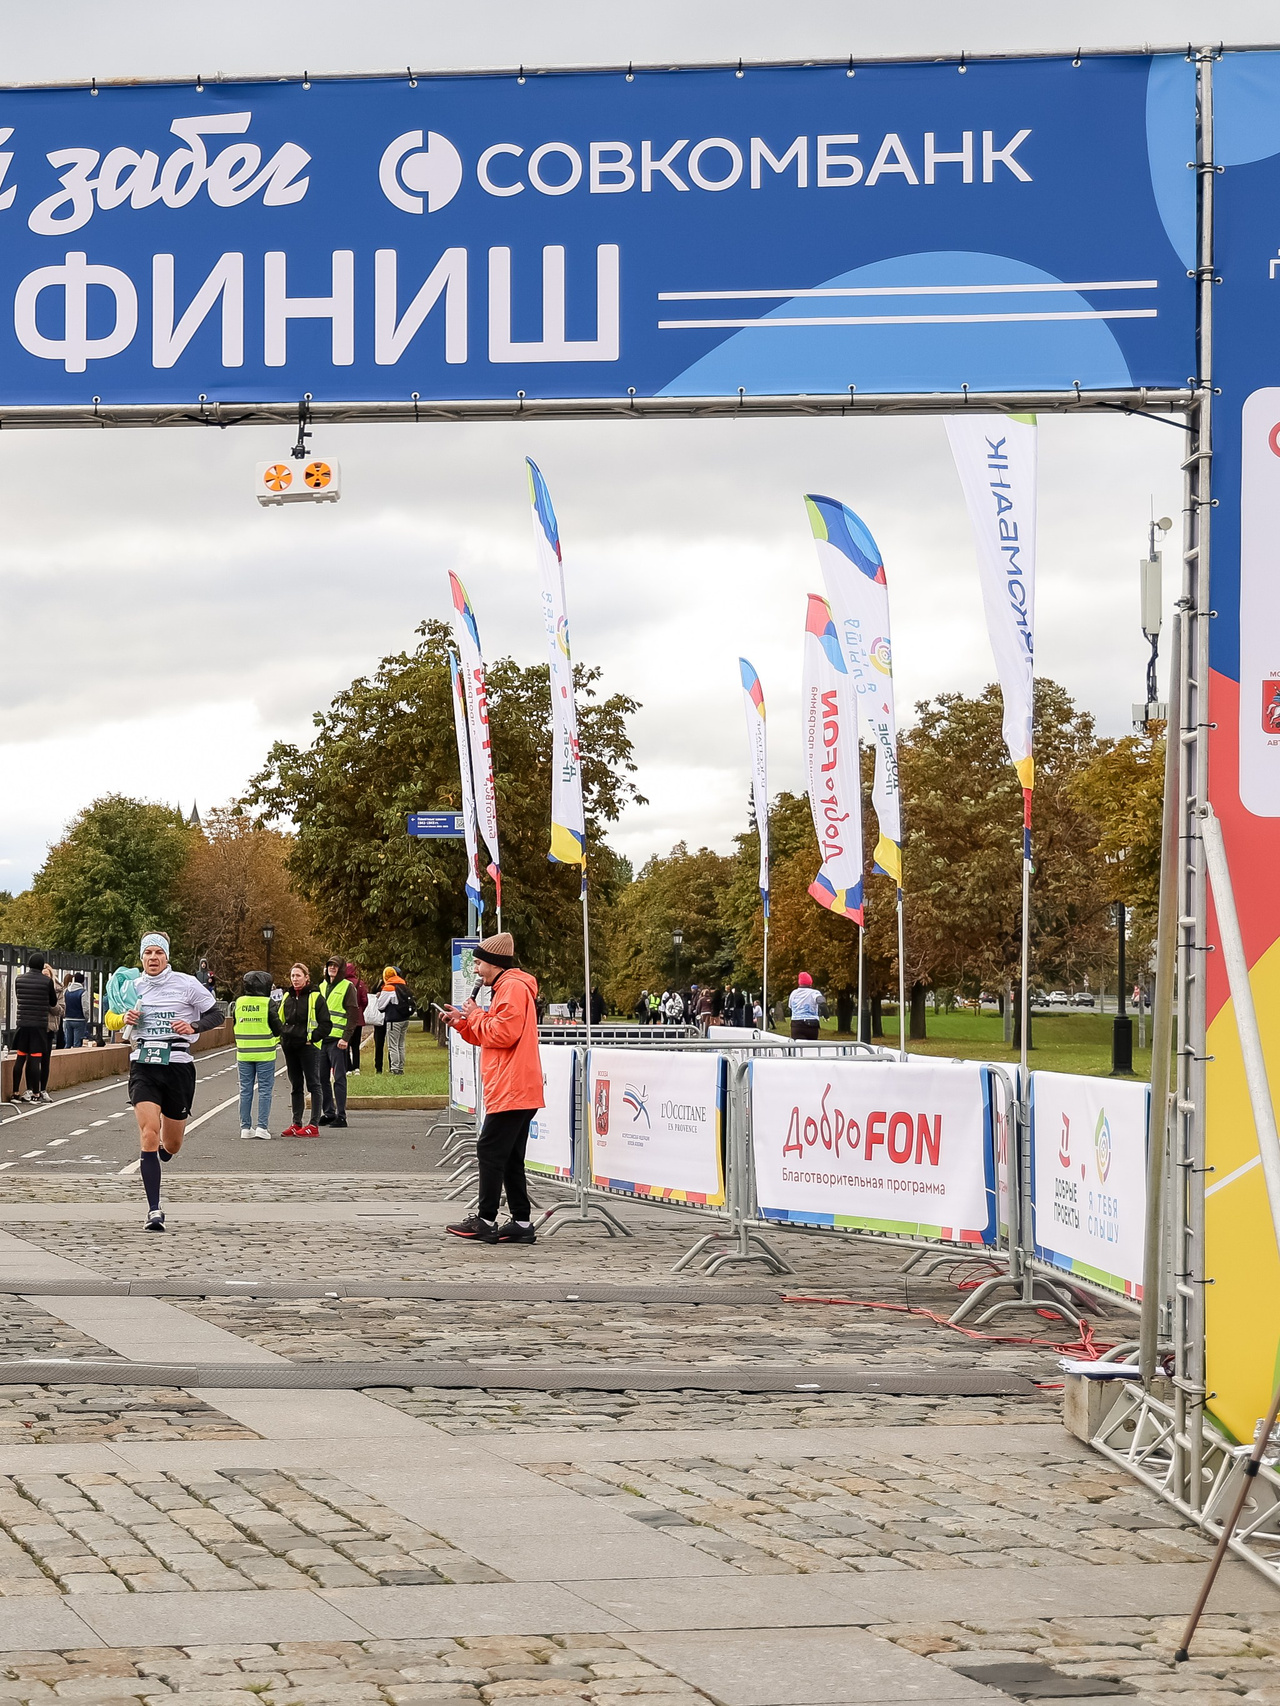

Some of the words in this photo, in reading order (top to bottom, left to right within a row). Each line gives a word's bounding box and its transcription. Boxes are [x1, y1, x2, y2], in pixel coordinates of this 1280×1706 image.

[28, 111, 312, 237] забег
[477, 129, 1034, 198] СОВКОМБАНК
[14, 244, 621, 374] ФИНИШ
[782, 1167, 884, 1190] Благотворительная
[887, 1178, 946, 1197] программа
[1054, 1177, 1078, 1204] ДОБРЫЕ
[1053, 1201, 1081, 1230] ПРОЕКТЫ
[1098, 1193, 1119, 1218] ТЕБЯ
[1088, 1215, 1120, 1244] СЛЫШУ
